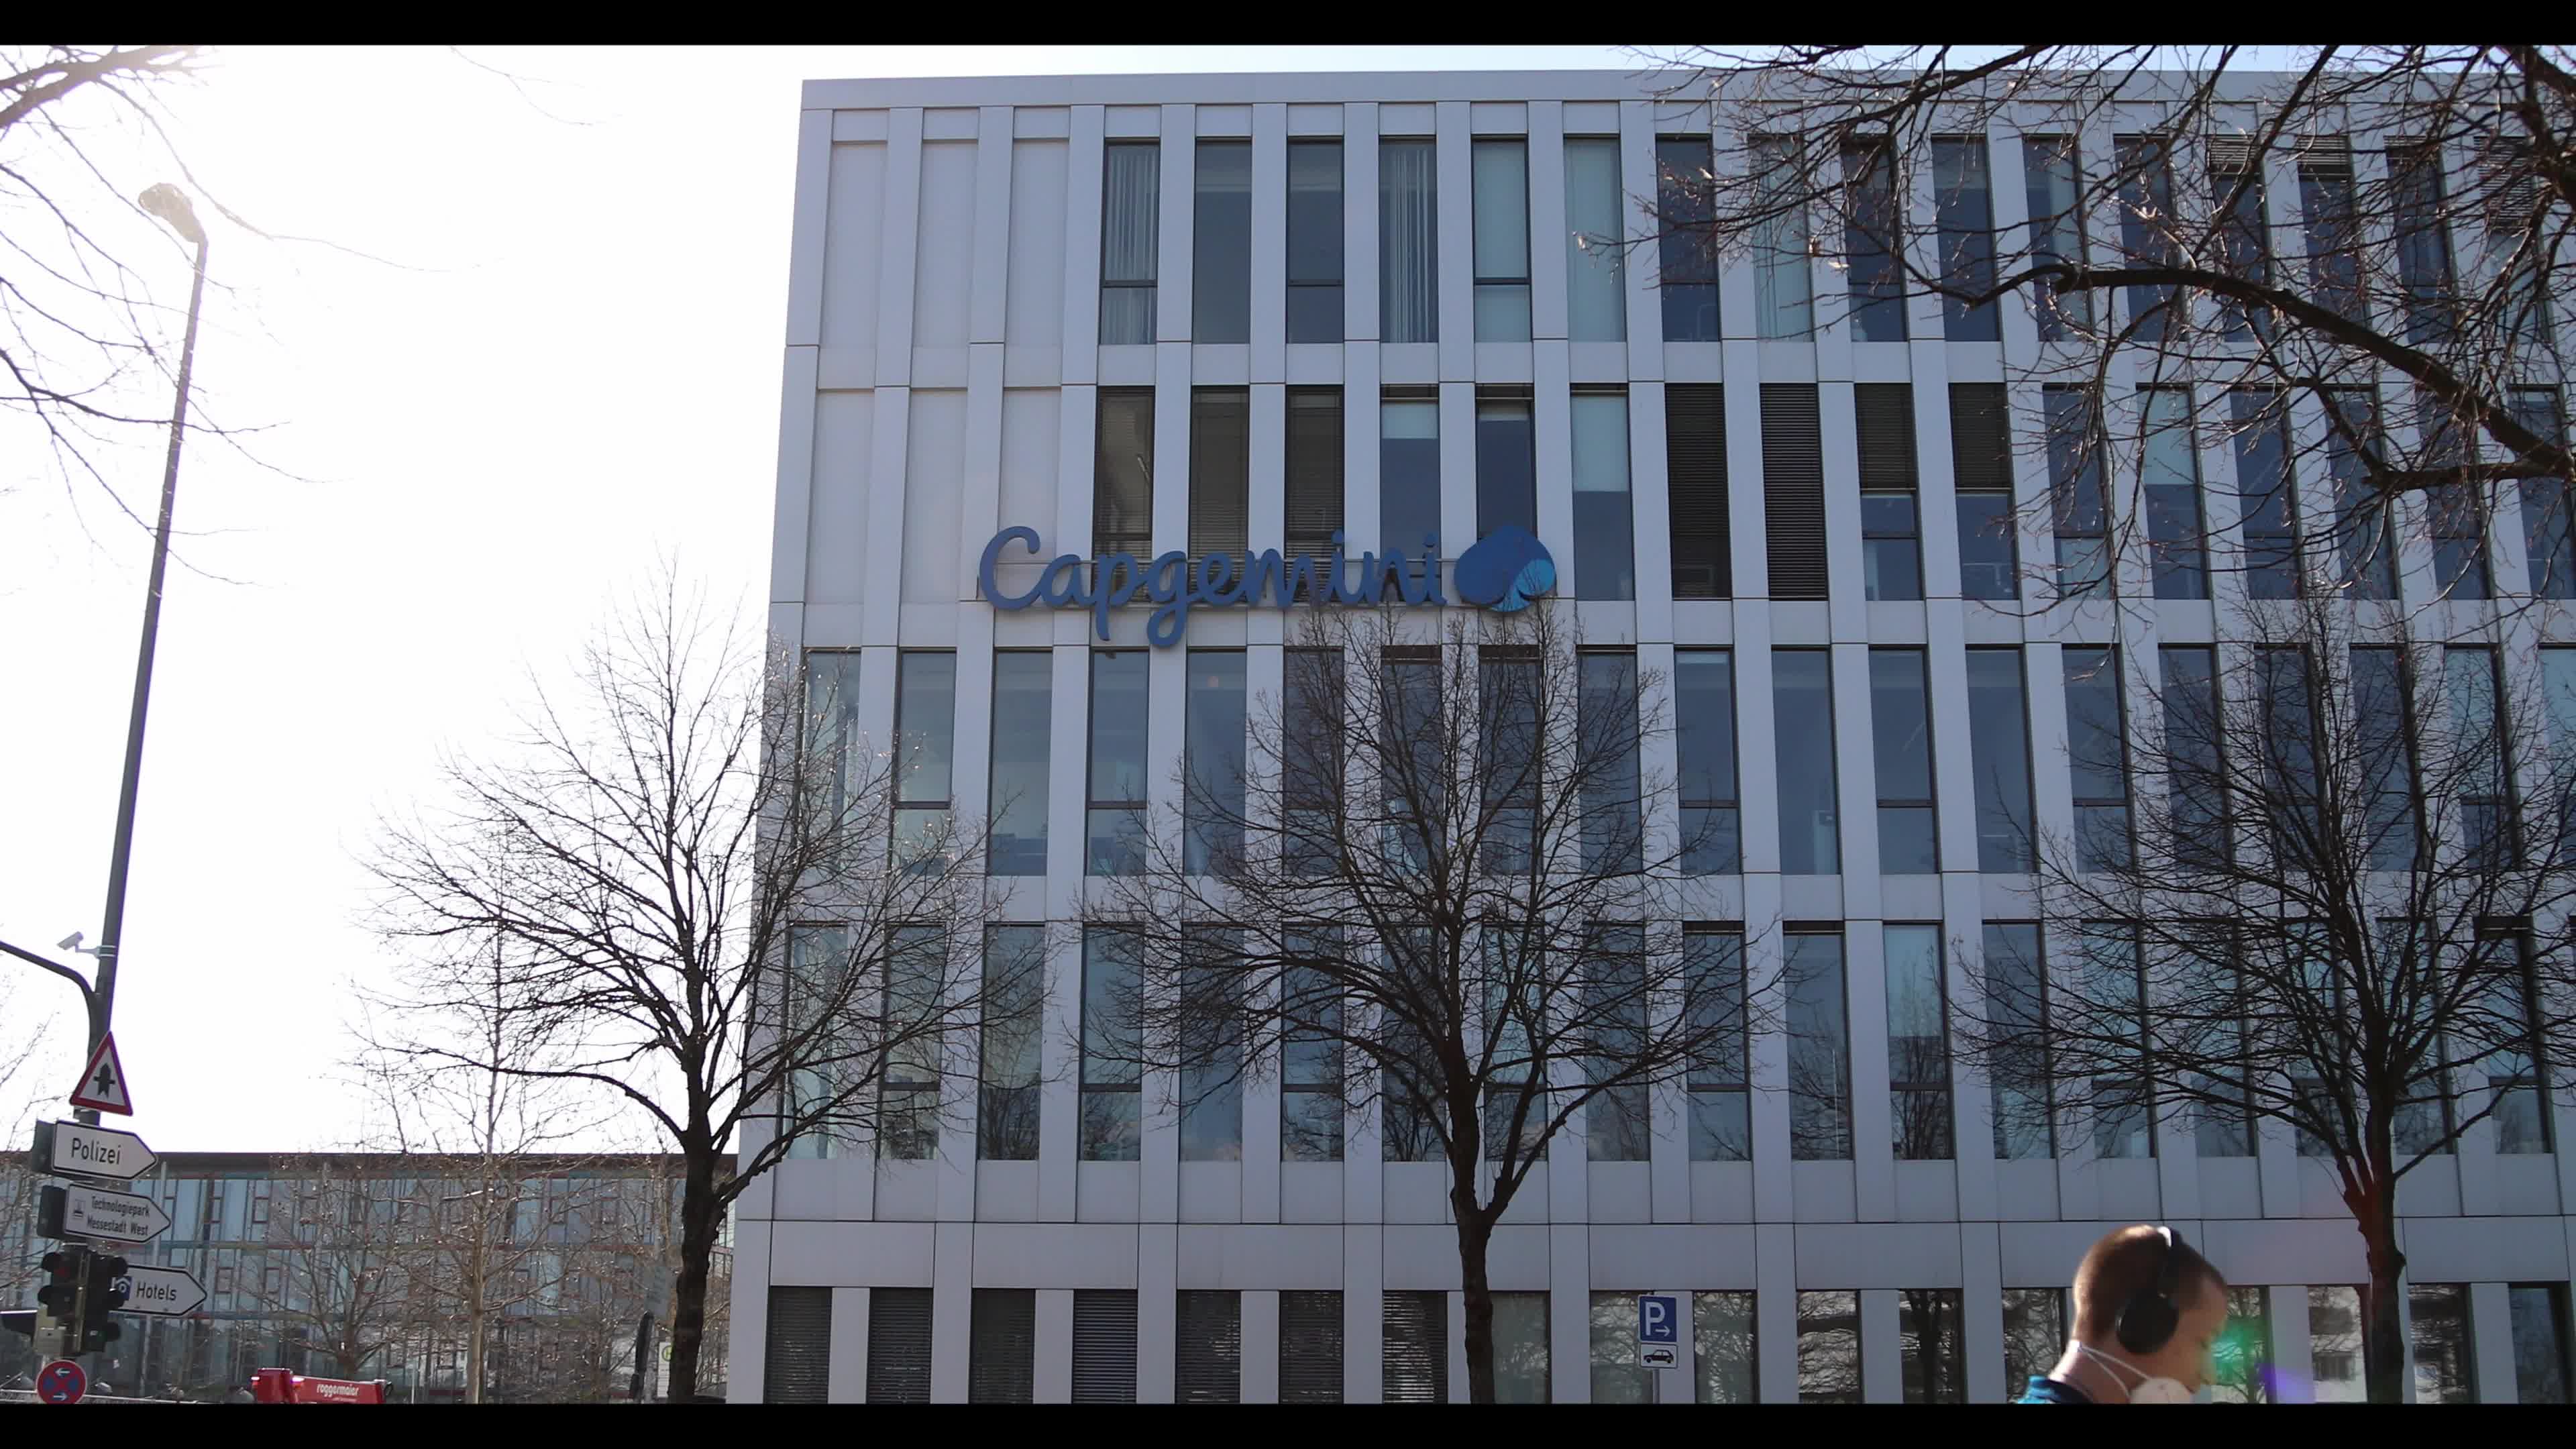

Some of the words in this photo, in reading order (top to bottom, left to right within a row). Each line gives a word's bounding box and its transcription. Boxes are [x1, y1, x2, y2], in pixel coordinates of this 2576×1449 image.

[979, 525, 1448, 647] Capgemini
[71, 1137, 121, 1165] Polizei
[92, 1195, 150, 1218] Technologiepark
[87, 1214, 127, 1234] Messestadt
[130, 1223, 149, 1236] West
[136, 1282, 177, 1301] Hotels
[1646, 1301, 1666, 1336] P
